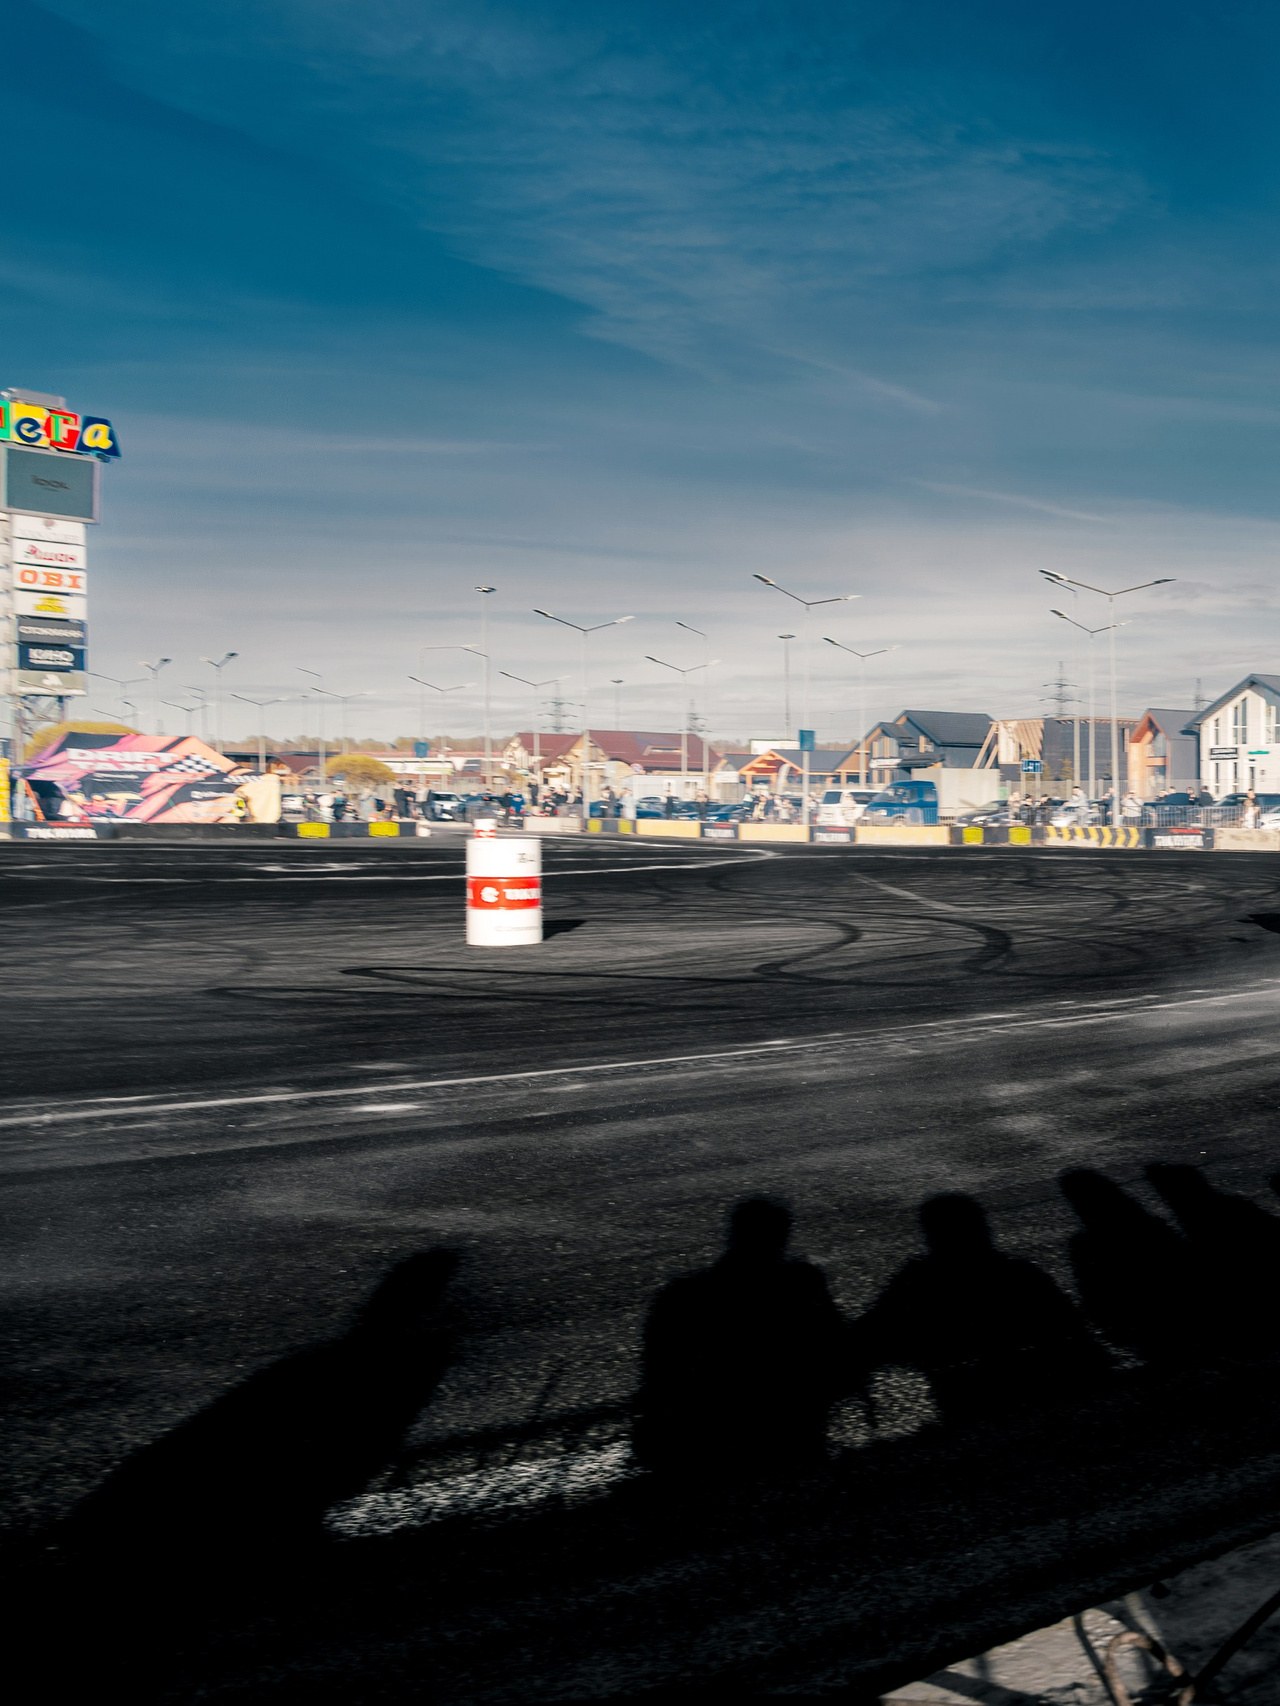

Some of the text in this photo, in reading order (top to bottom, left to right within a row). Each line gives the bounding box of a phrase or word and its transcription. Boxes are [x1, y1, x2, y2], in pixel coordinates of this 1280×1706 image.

[19, 569, 82, 589] OBI
[66, 748, 178, 763] DRIFT
[69, 761, 160, 772] TAXI
